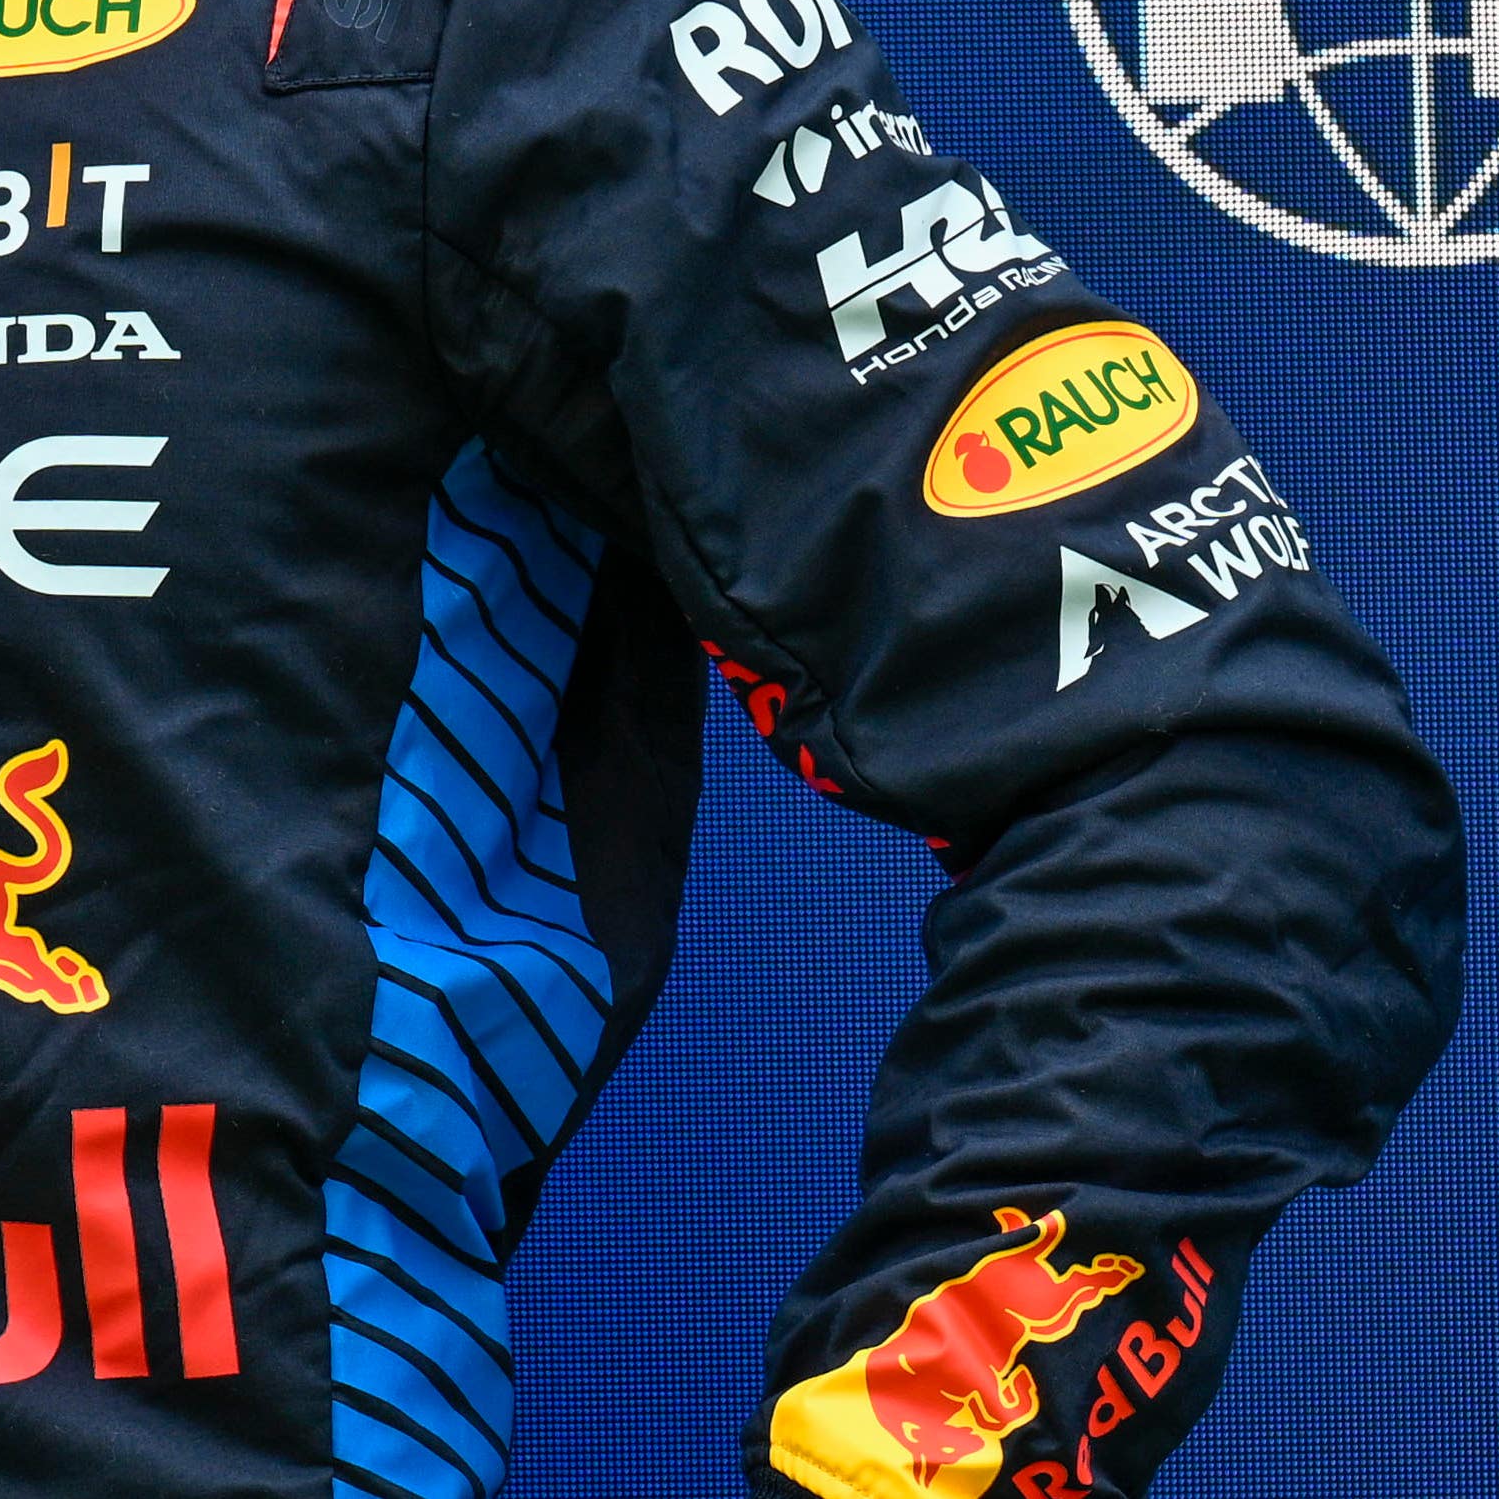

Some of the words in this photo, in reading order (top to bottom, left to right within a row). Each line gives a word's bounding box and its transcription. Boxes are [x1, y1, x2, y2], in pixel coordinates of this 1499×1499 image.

[850, 284, 1003, 387] Honda
[994, 350, 1177, 470] RAUCH
[1124, 453, 1289, 570] ARCTI
[1186, 513, 1312, 602] WOLF
[1116, 1235, 1215, 1400] Bull
